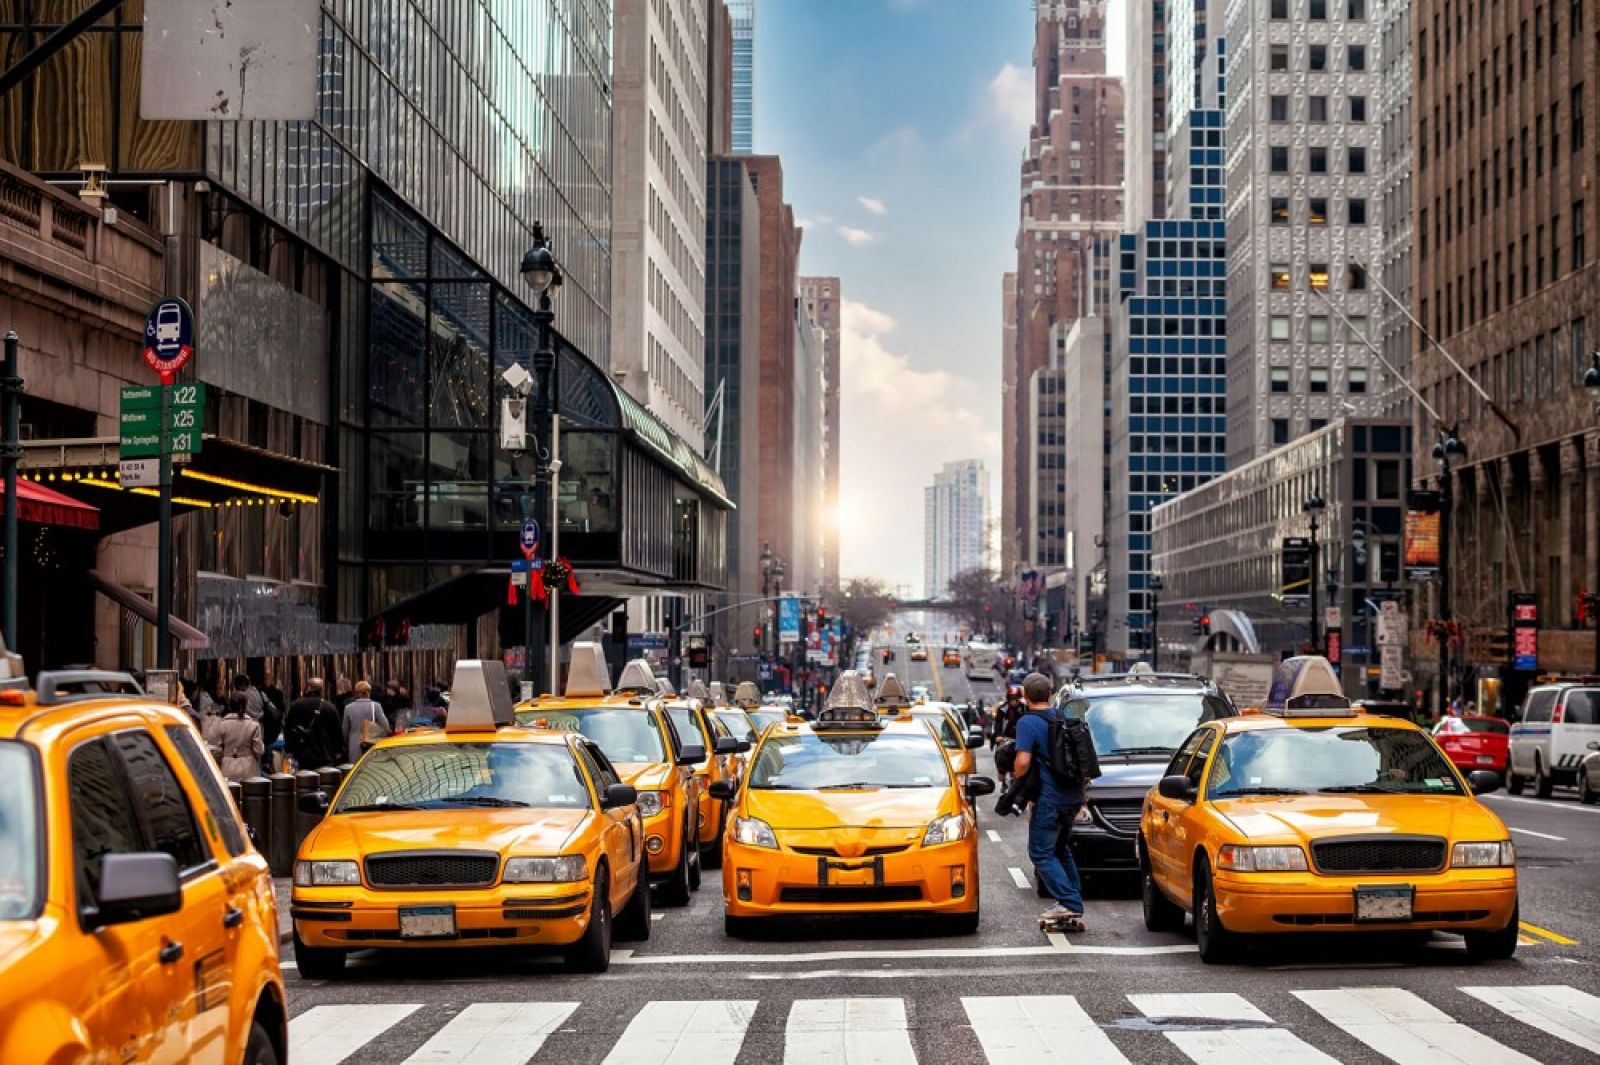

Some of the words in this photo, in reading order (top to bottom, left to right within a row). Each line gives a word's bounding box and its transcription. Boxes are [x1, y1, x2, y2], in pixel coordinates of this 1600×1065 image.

[174, 387, 196, 404] x22
[174, 410, 194, 427] x25
[172, 432, 192, 451] x31
